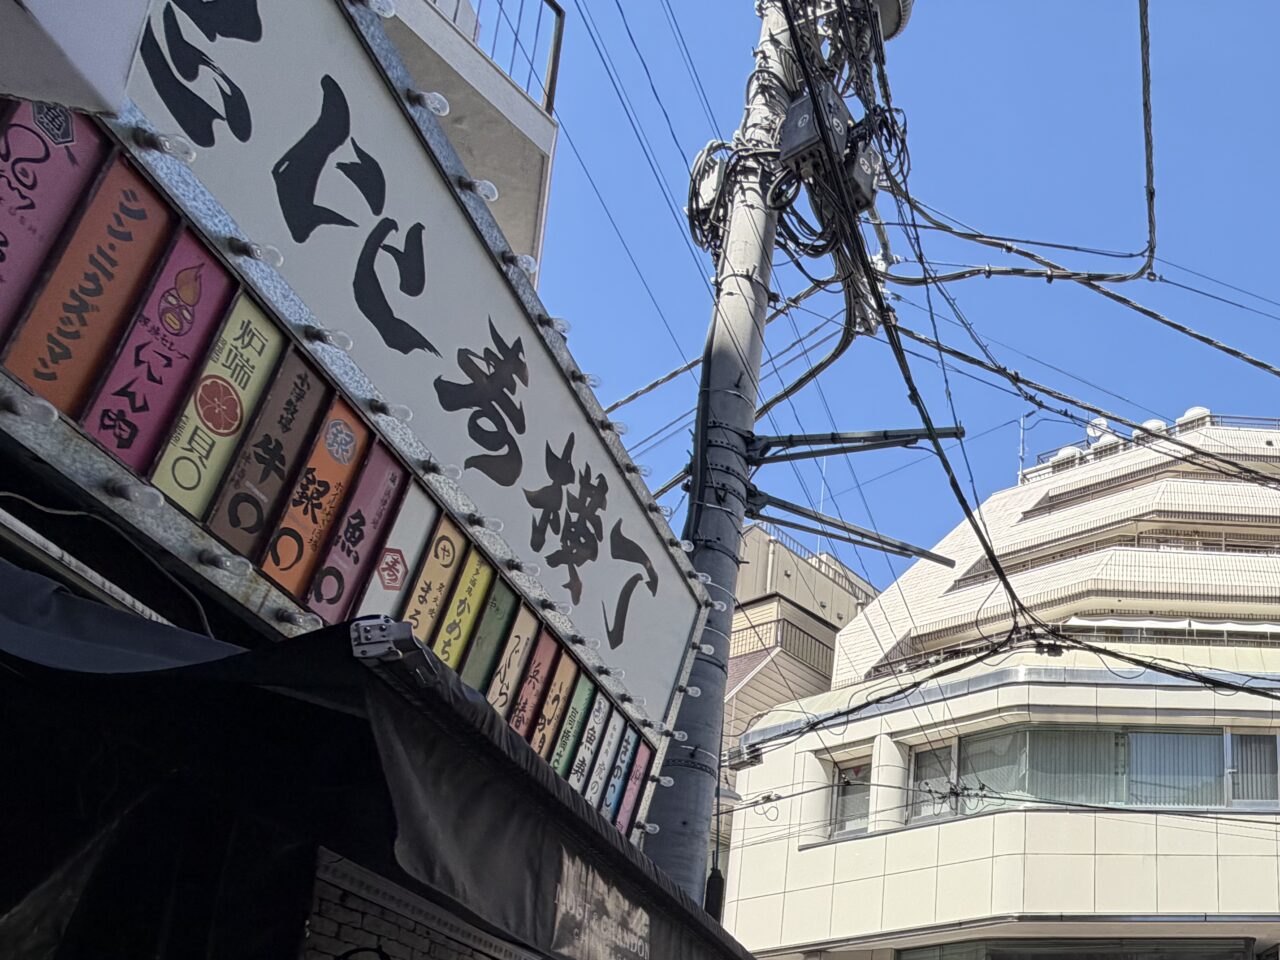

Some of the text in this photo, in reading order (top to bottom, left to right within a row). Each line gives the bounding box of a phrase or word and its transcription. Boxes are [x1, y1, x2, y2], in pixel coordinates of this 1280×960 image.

[221, 319, 269, 391] 炉端
[439, 596, 472, 663] かめち
